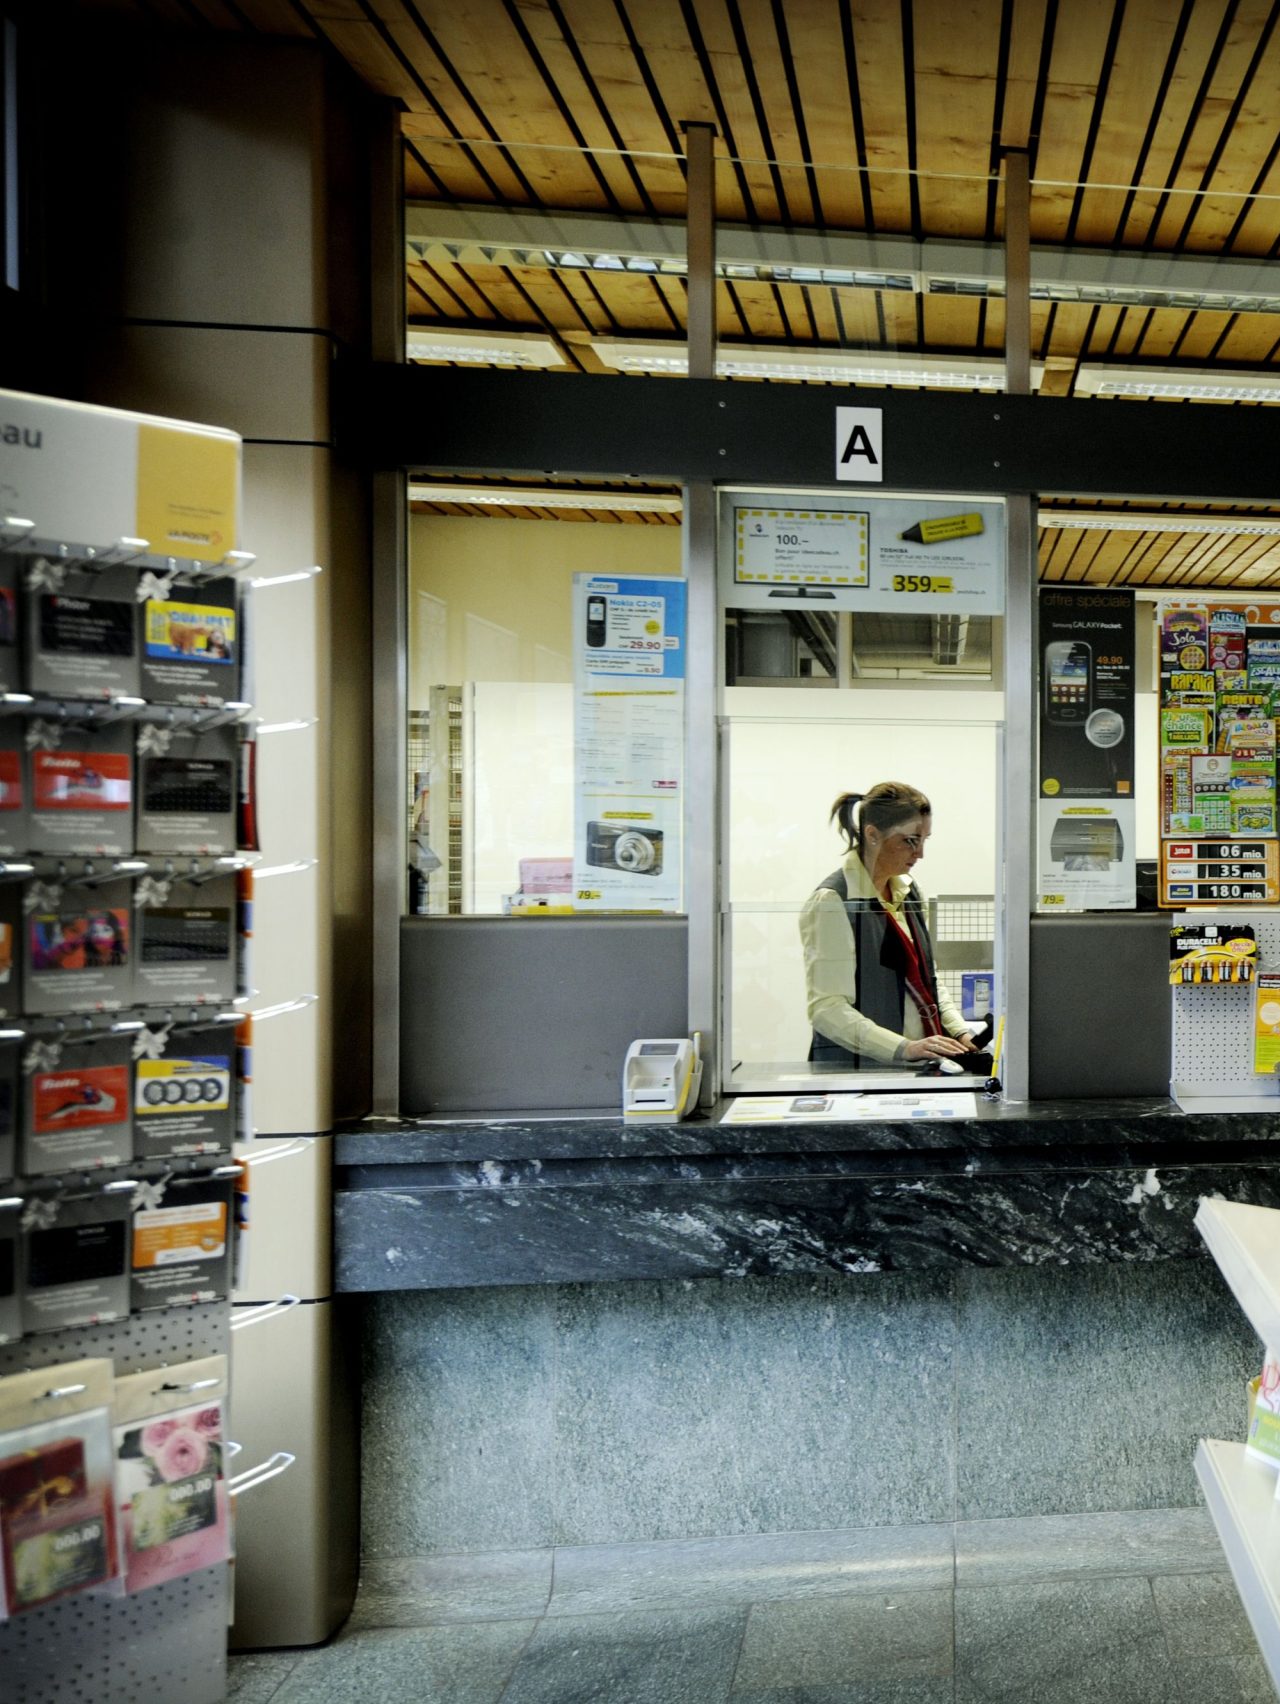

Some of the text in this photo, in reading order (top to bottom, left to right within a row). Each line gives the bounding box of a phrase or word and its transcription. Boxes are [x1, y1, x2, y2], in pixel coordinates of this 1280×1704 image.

[840, 424, 880, 466] A
[609, 599, 634, 607] Nokia
[1044, 592, 1132, 609] offre spéciale
[1073, 620, 1101, 629] GALAXY
[1168, 632, 1196, 646] Solo
[630, 640, 661, 650] 29.90
[1096, 655, 1124, 665] 49.90
[1176, 938, 1218, 946] DURACELL
